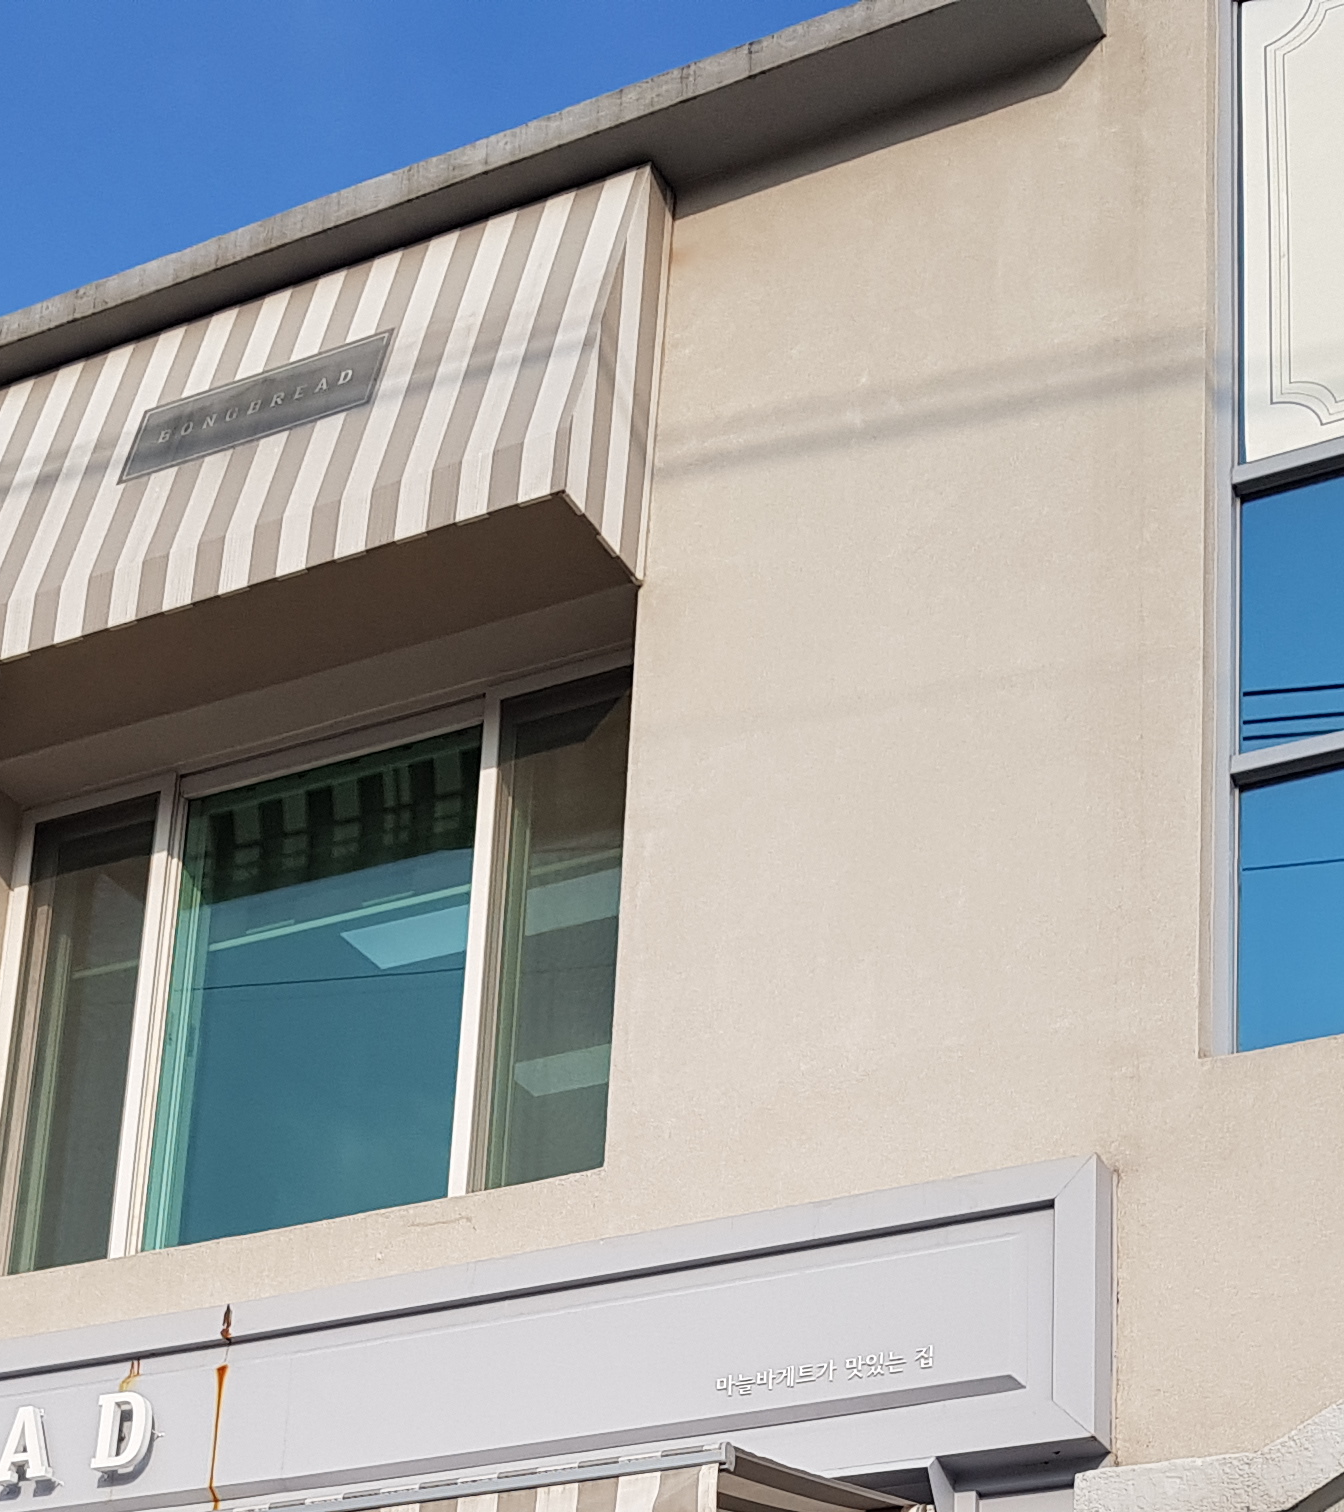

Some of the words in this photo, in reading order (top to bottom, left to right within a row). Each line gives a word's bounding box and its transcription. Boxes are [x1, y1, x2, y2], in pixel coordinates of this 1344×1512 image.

[715, 1358, 837, 1397] 마늘바게트가
[845, 1352, 907, 1381] 맛있는
[914, 1344, 935, 1369] 집
